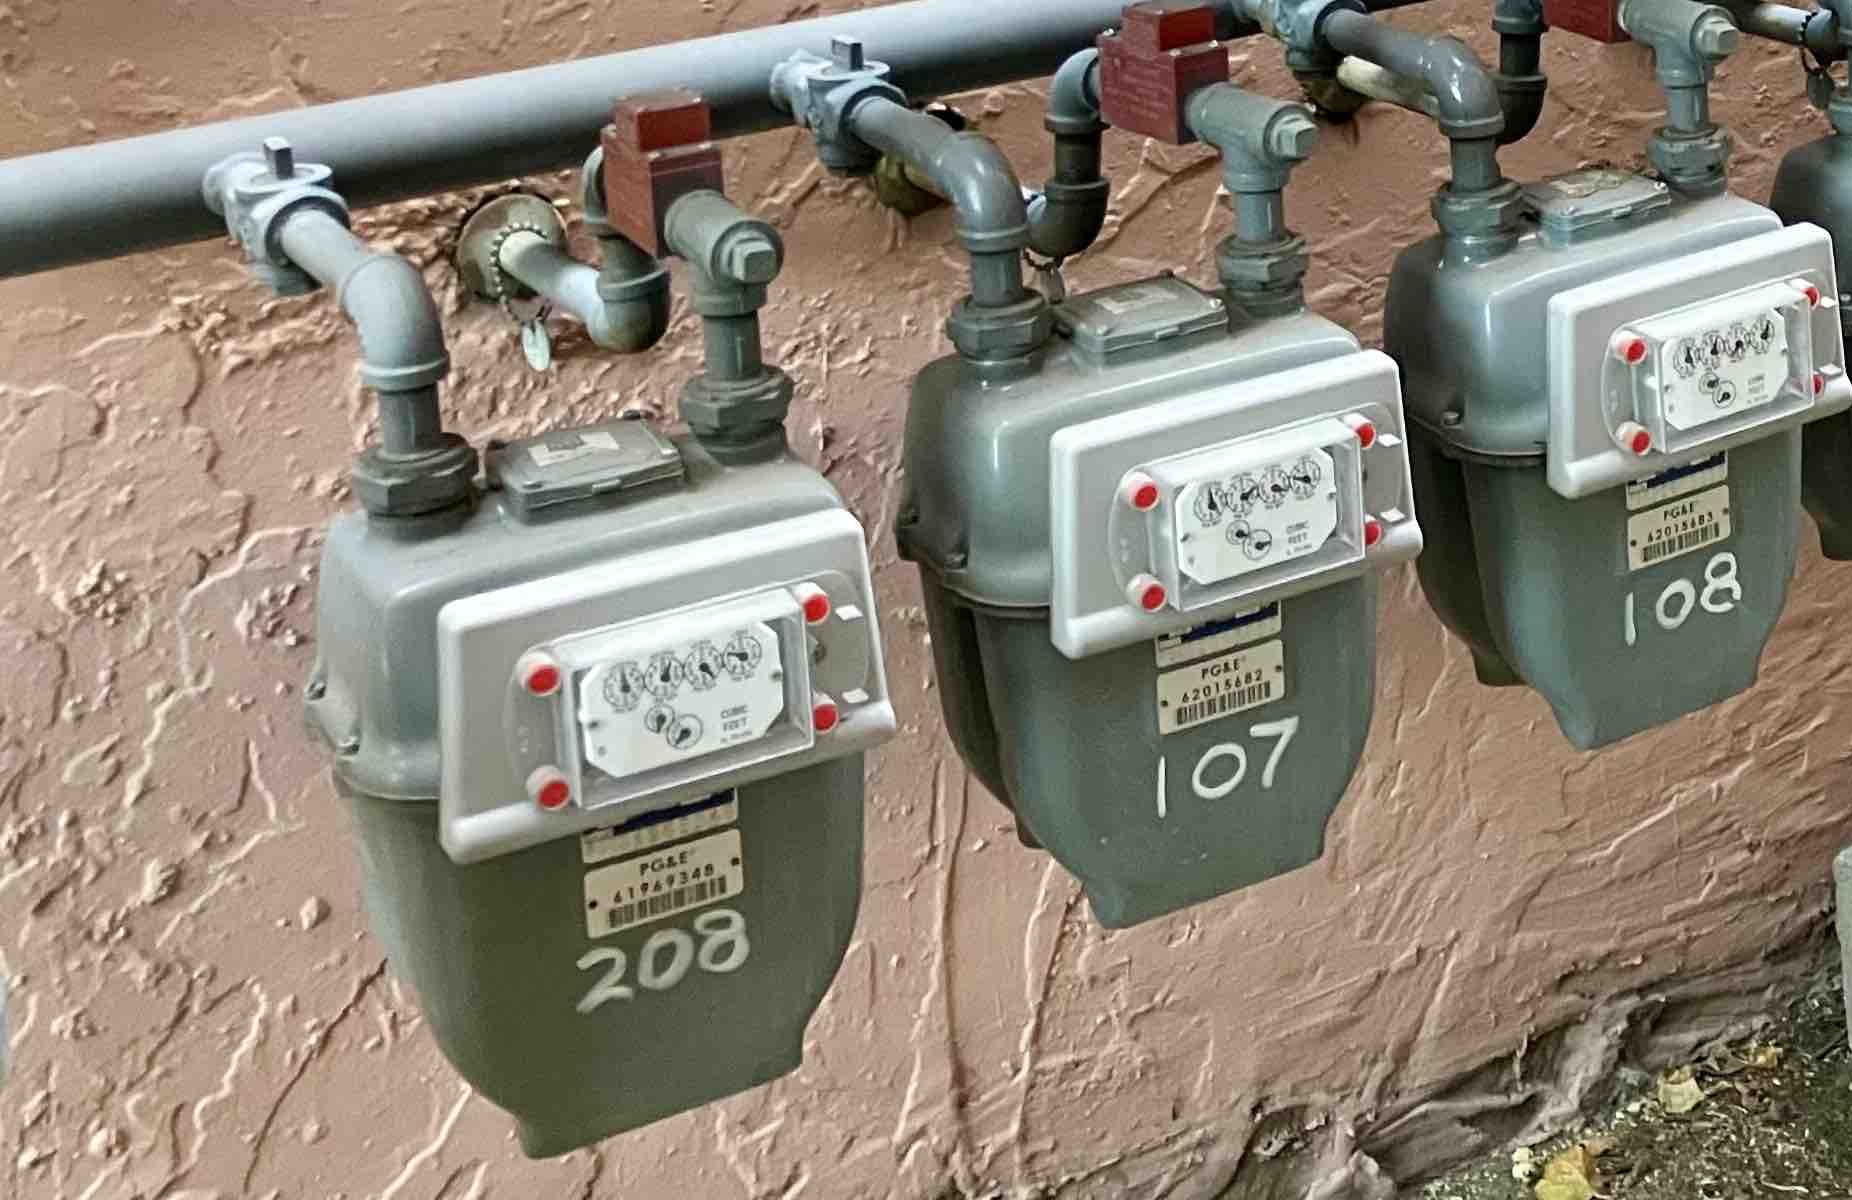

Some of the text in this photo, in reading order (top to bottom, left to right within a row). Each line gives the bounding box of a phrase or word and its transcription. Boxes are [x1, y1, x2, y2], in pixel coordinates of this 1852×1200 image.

[1663, 503, 1695, 521] PG&E
[1625, 552, 1742, 646] 108
[1201, 658, 1241, 680] PG&E
[1181, 669, 1264, 704] 62015682
[723, 718, 748, 732] FEET
[1157, 716, 1299, 818] 107
[639, 851, 689, 876] PG&E
[576, 909, 750, 1013] 208
